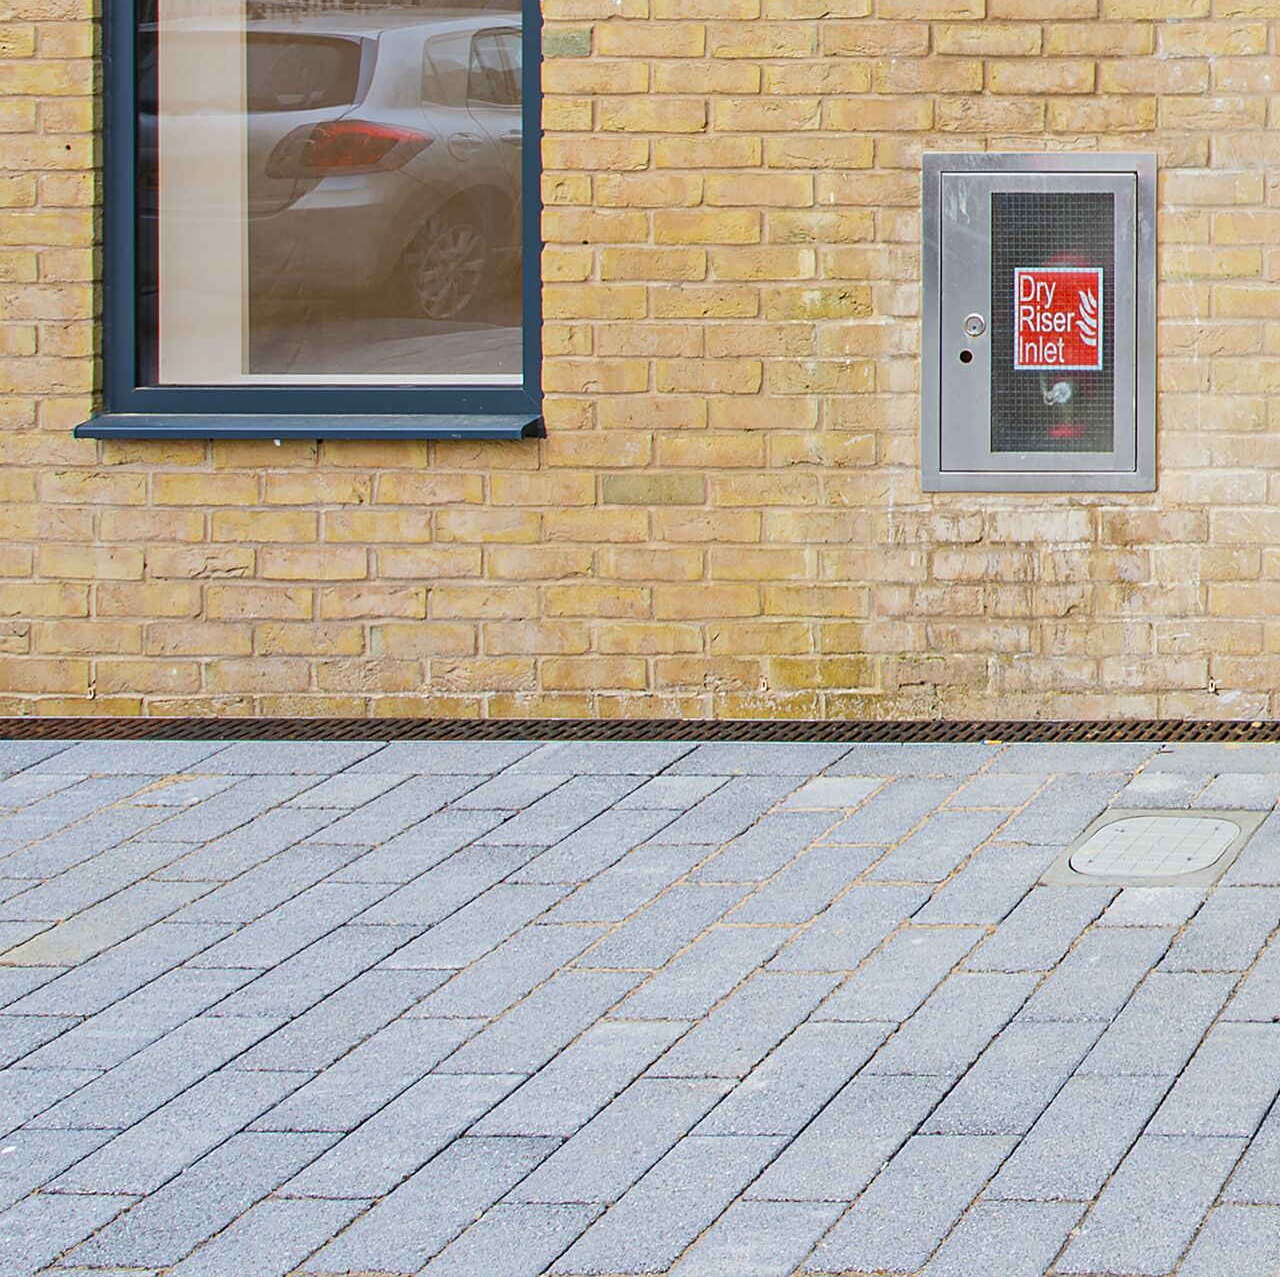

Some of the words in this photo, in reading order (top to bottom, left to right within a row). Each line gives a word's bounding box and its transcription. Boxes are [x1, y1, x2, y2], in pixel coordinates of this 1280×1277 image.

[1020, 275, 1056, 309] Dry
[1020, 305, 1075, 332] Riser
[1019, 335, 1065, 363] Inlet
